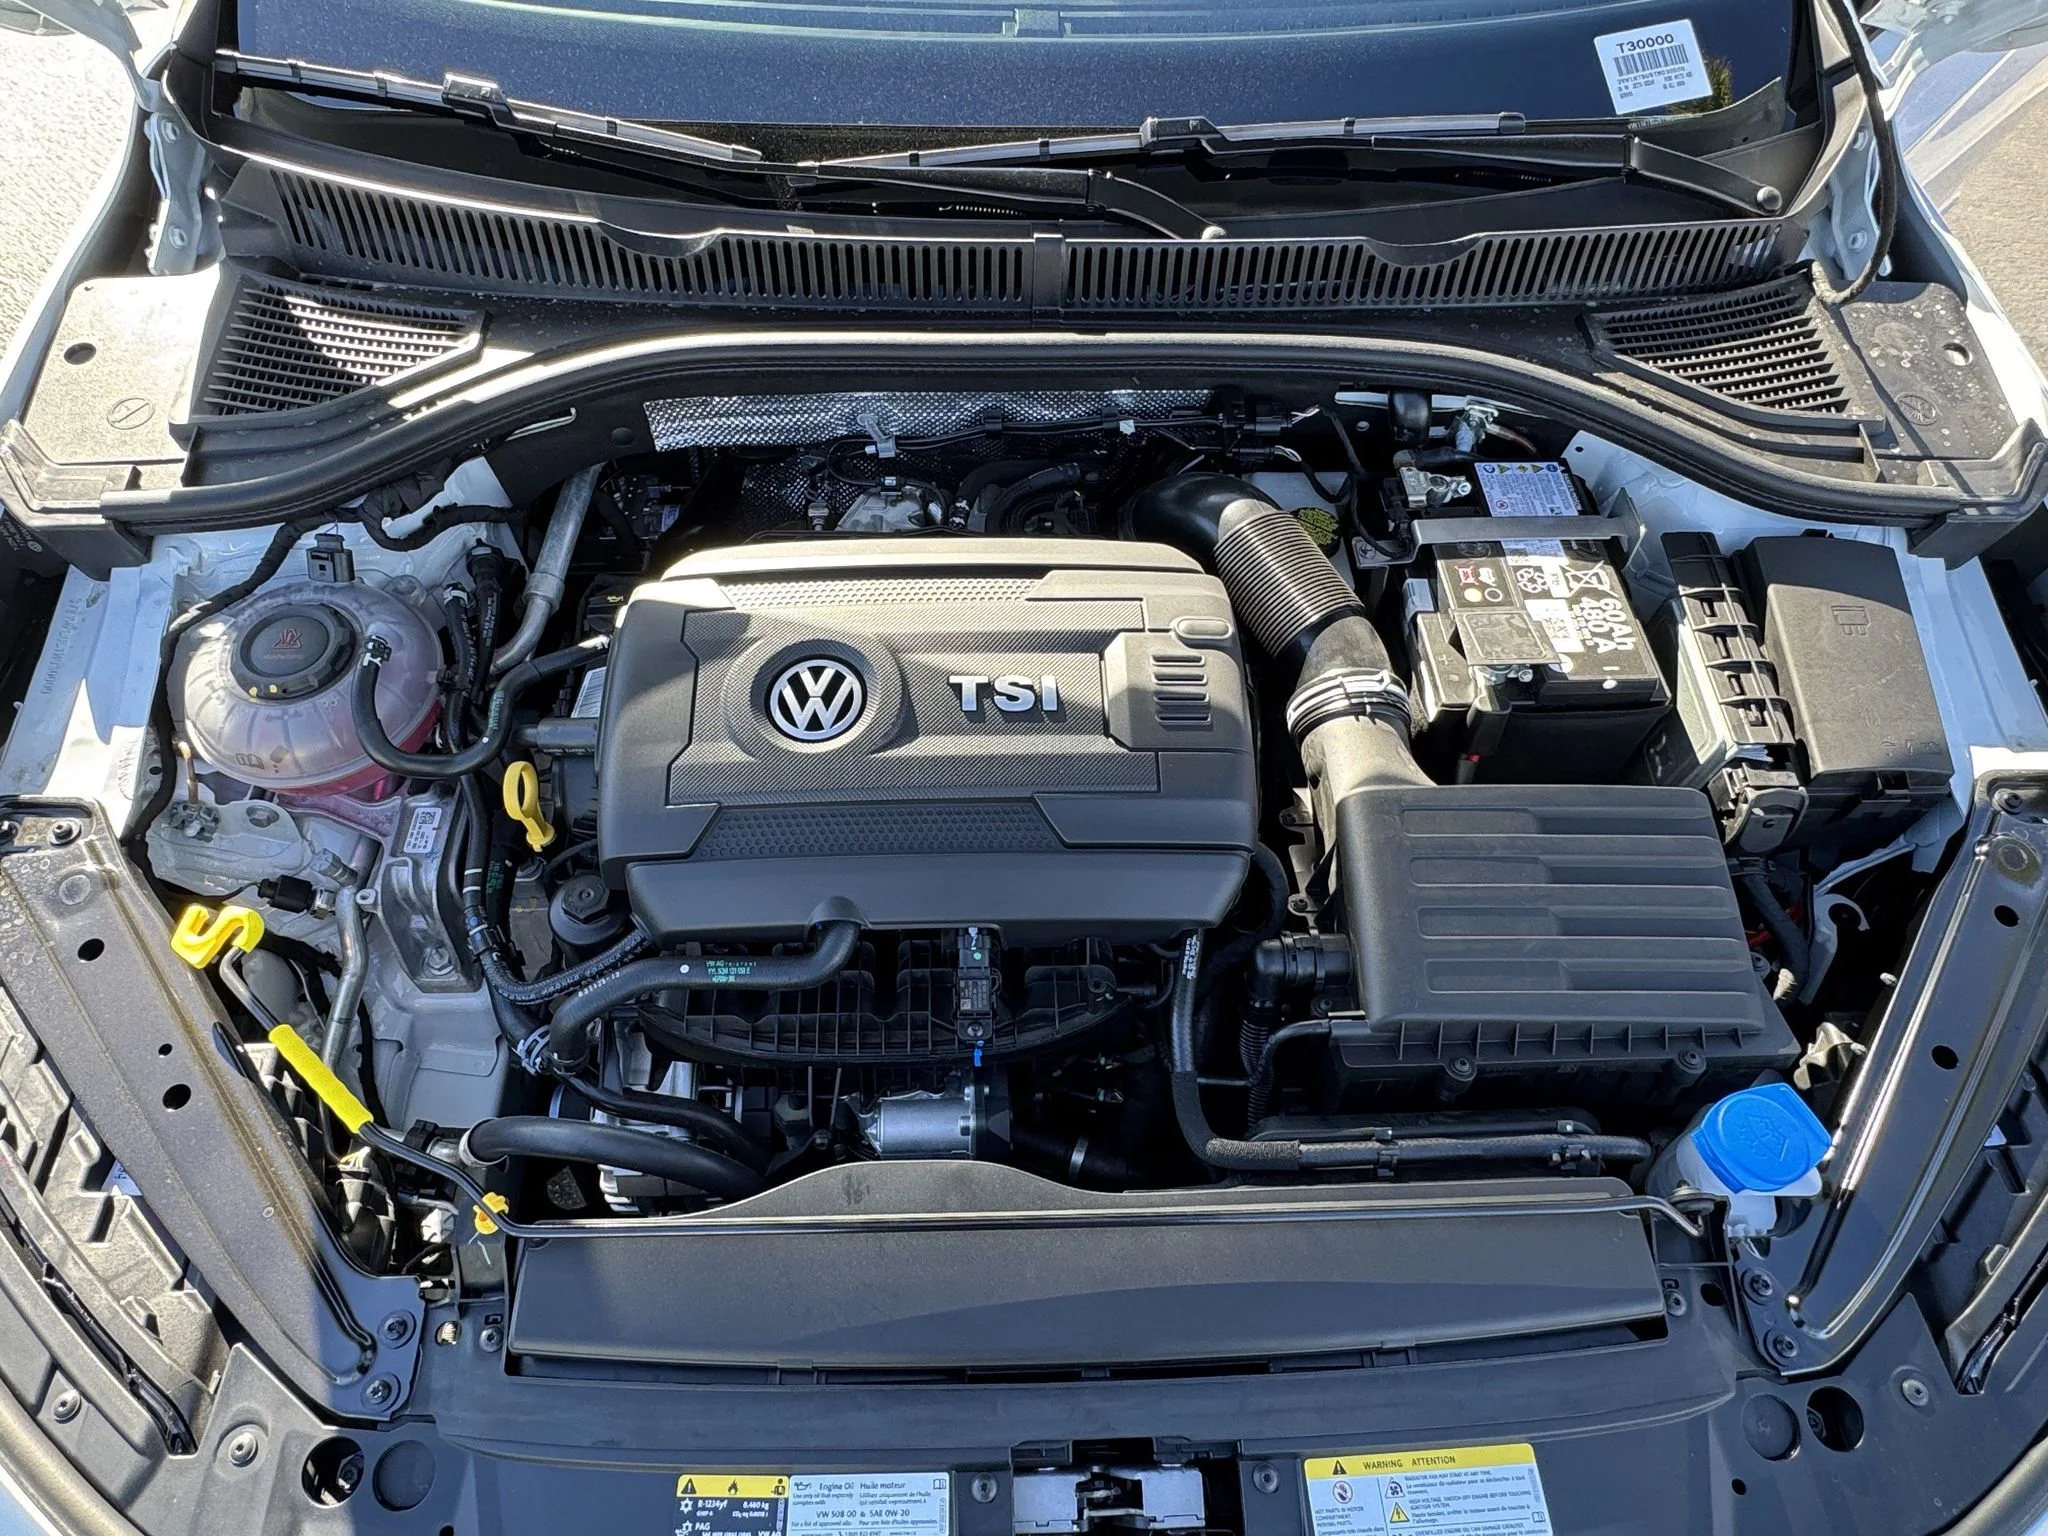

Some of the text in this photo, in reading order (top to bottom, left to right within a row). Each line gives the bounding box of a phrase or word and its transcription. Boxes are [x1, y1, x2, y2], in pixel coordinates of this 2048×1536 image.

[1616, 34, 1674, 53] T30000
[1600, 598, 1636, 650] 60Ah
[769, 658, 863, 741] VW
[948, 674, 1058, 713] TSI
[1363, 1455, 1456, 1470] WARNING ATTENTION
[819, 1482, 842, 1492] Engine
[844, 1482, 855, 1490] Oil
[860, 1482, 878, 1490] Huile
[816, 1510, 830, 1518] VW
[831, 1510, 845, 1518] 508
[846, 1510, 857, 1518] 00
[869, 1509, 883, 1517] SAE
[695, 1522, 711, 1531] PAG
